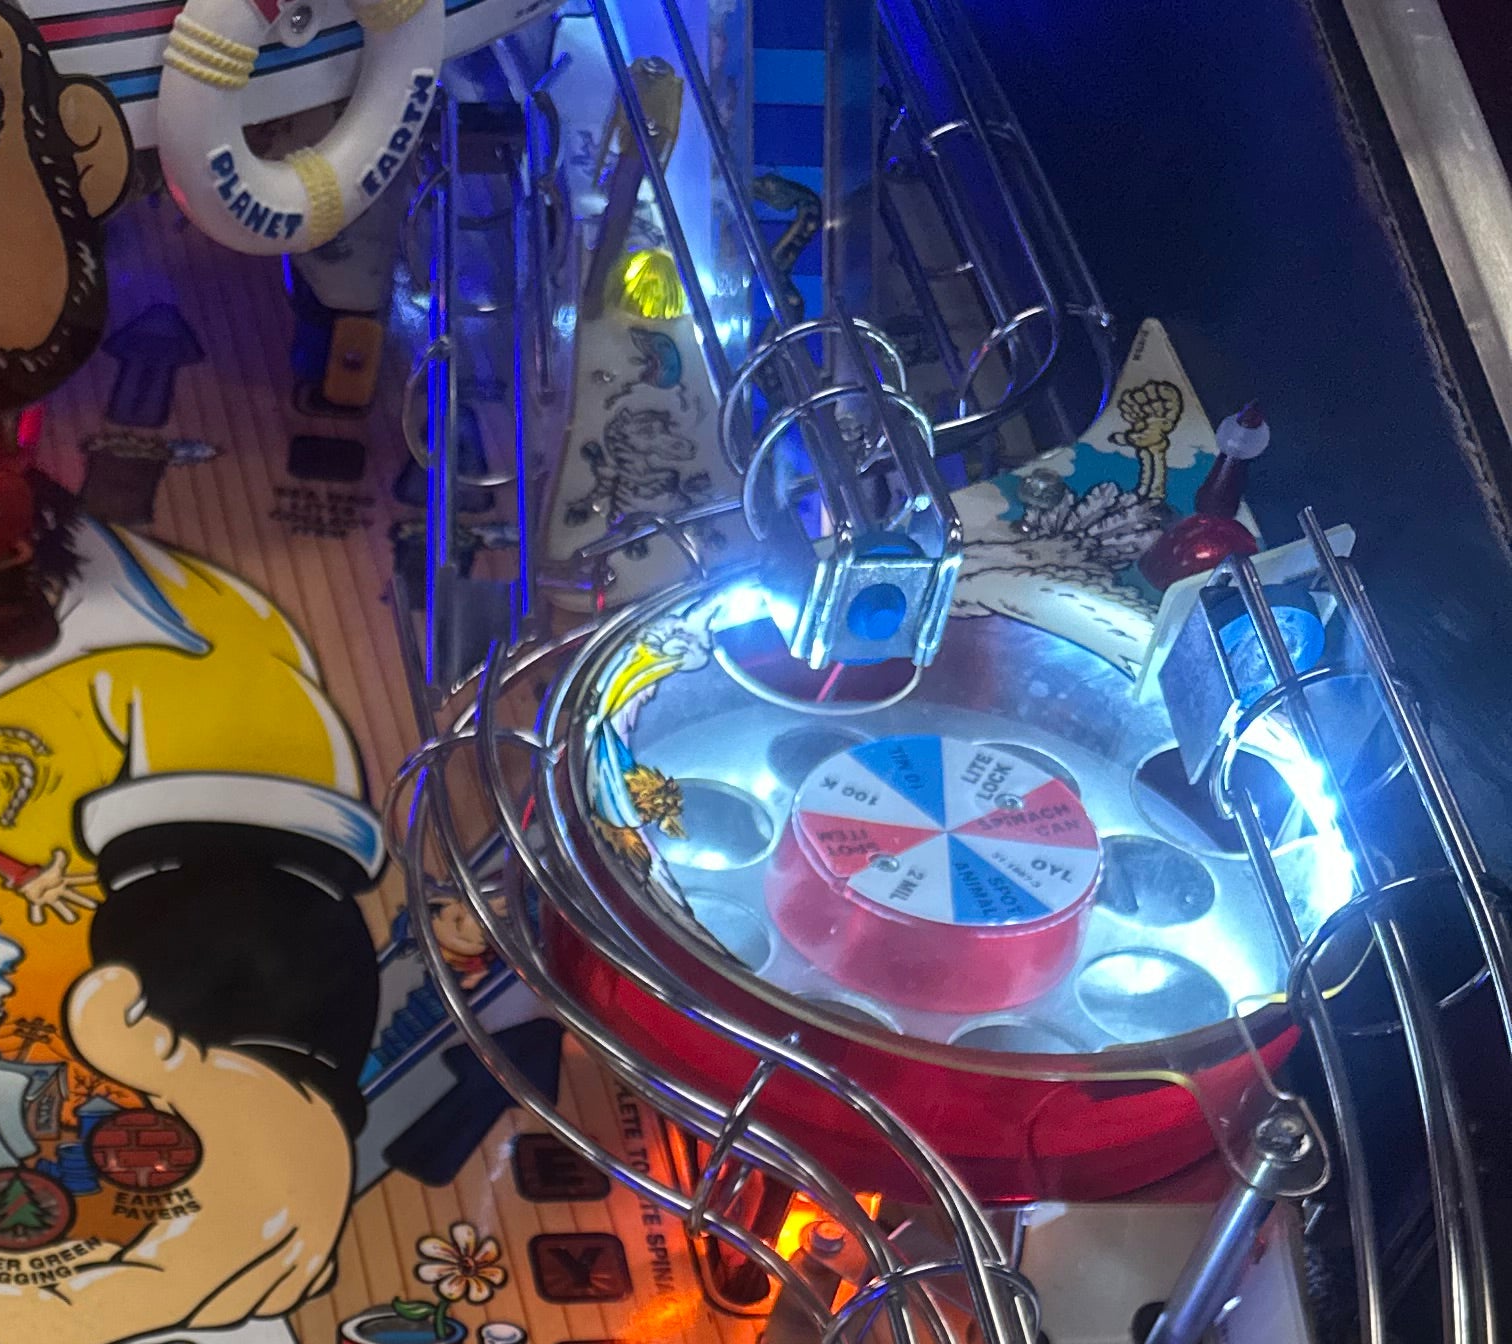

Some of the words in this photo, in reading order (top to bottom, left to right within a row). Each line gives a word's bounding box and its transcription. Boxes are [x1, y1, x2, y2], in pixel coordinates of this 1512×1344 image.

[210, 150, 303, 241] PLANET
[360, 75, 434, 197] EARTH
[960, 751, 994, 785] LITE
[975, 763, 1013, 802] LOCK
[841, 786, 879, 808] 100
[977, 803, 1072, 832] SPINACH
[1035, 818, 1082, 838] CAN
[906, 868, 925, 884] 2
[890, 879, 919, 902] MIL
[114, 1187, 194, 1208] EARTH
[111, 1201, 203, 1222] PAVERS
[28, 1236, 103, 1270] GREEN
